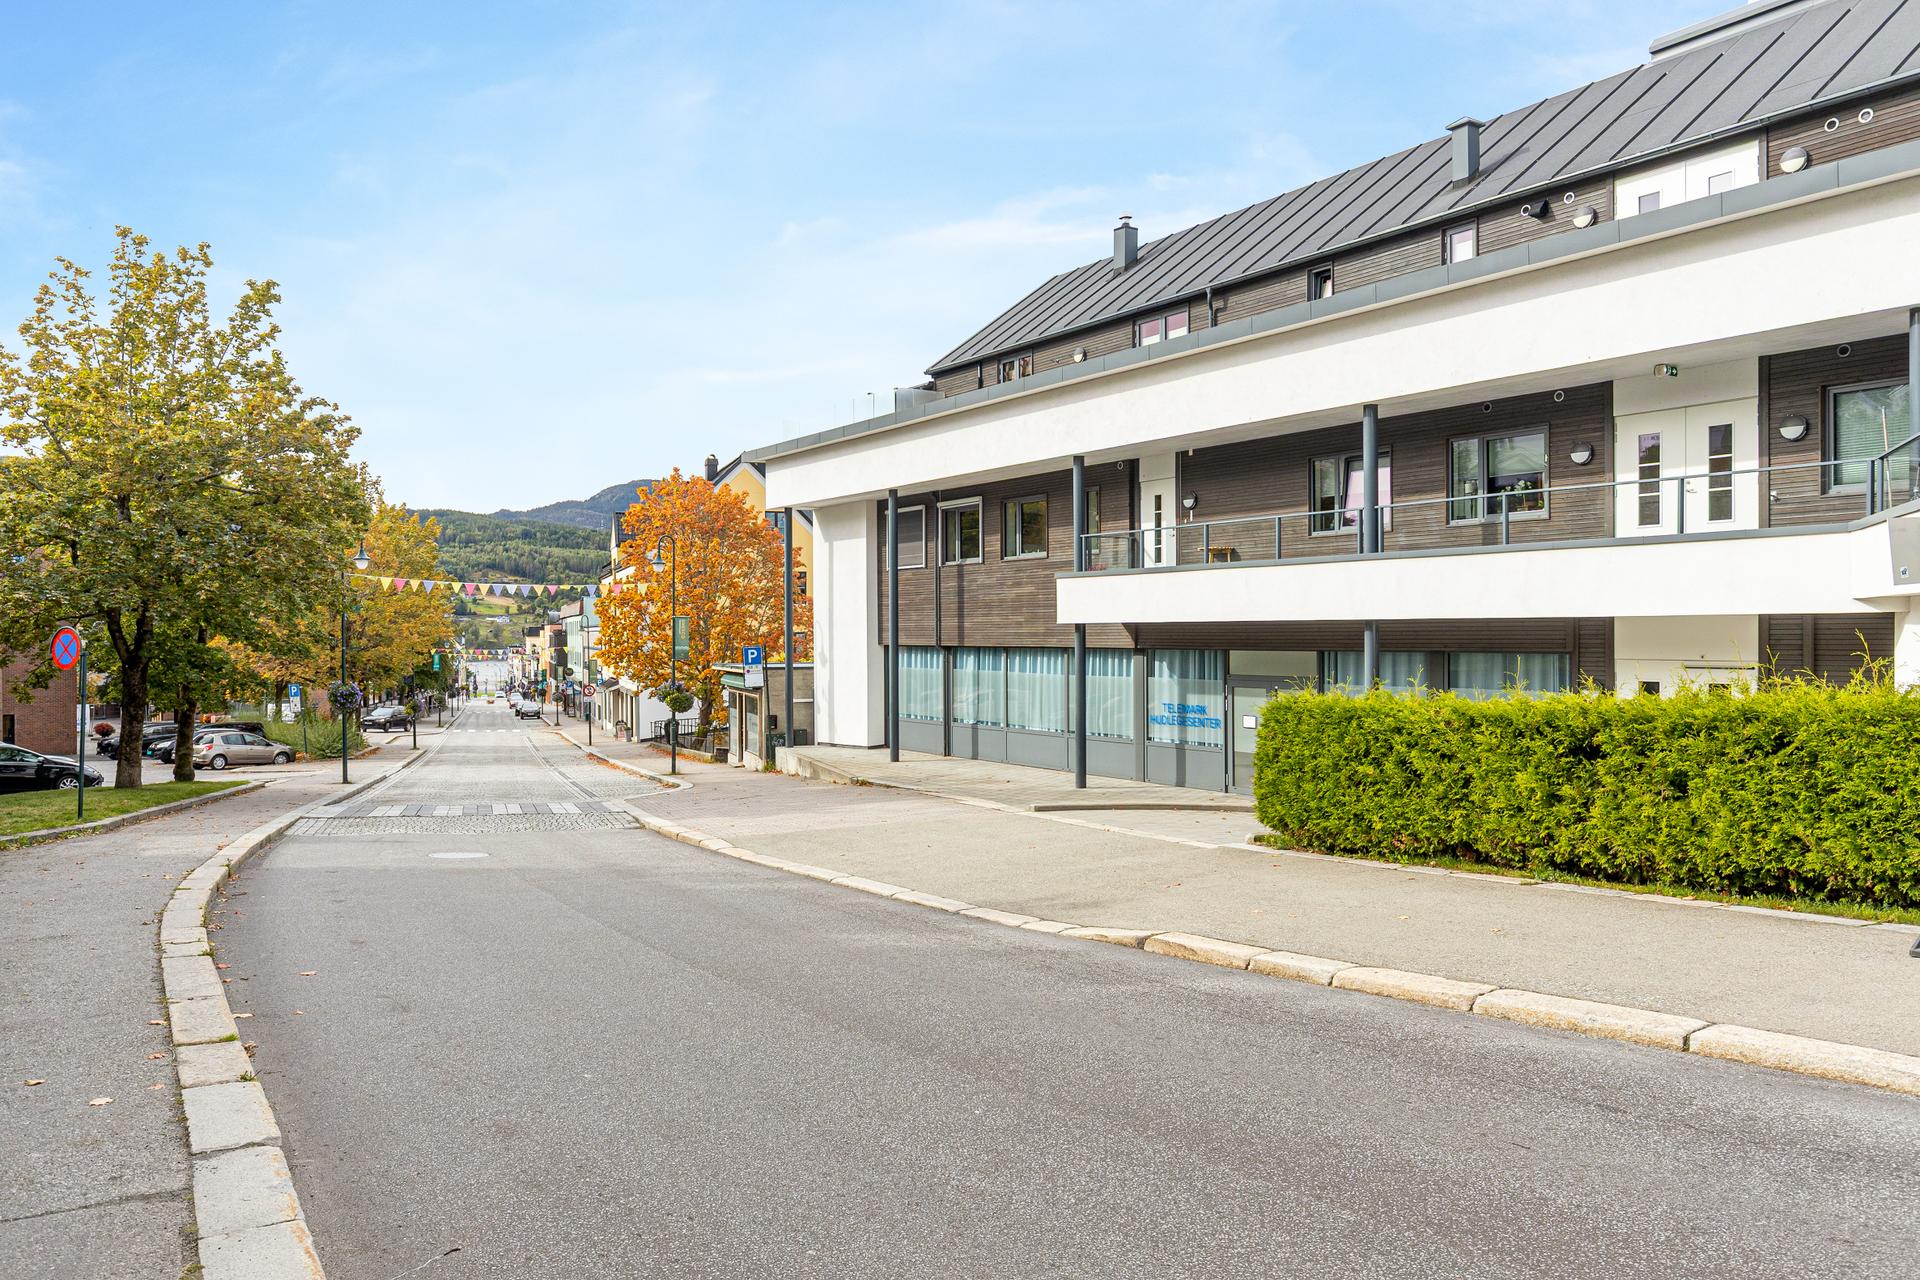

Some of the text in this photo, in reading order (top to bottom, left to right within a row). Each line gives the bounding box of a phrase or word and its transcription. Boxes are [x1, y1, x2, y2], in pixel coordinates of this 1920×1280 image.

[748, 649, 757, 663] P
[291, 686, 297, 696] P
[1162, 703, 1208, 716] TELEMARK
